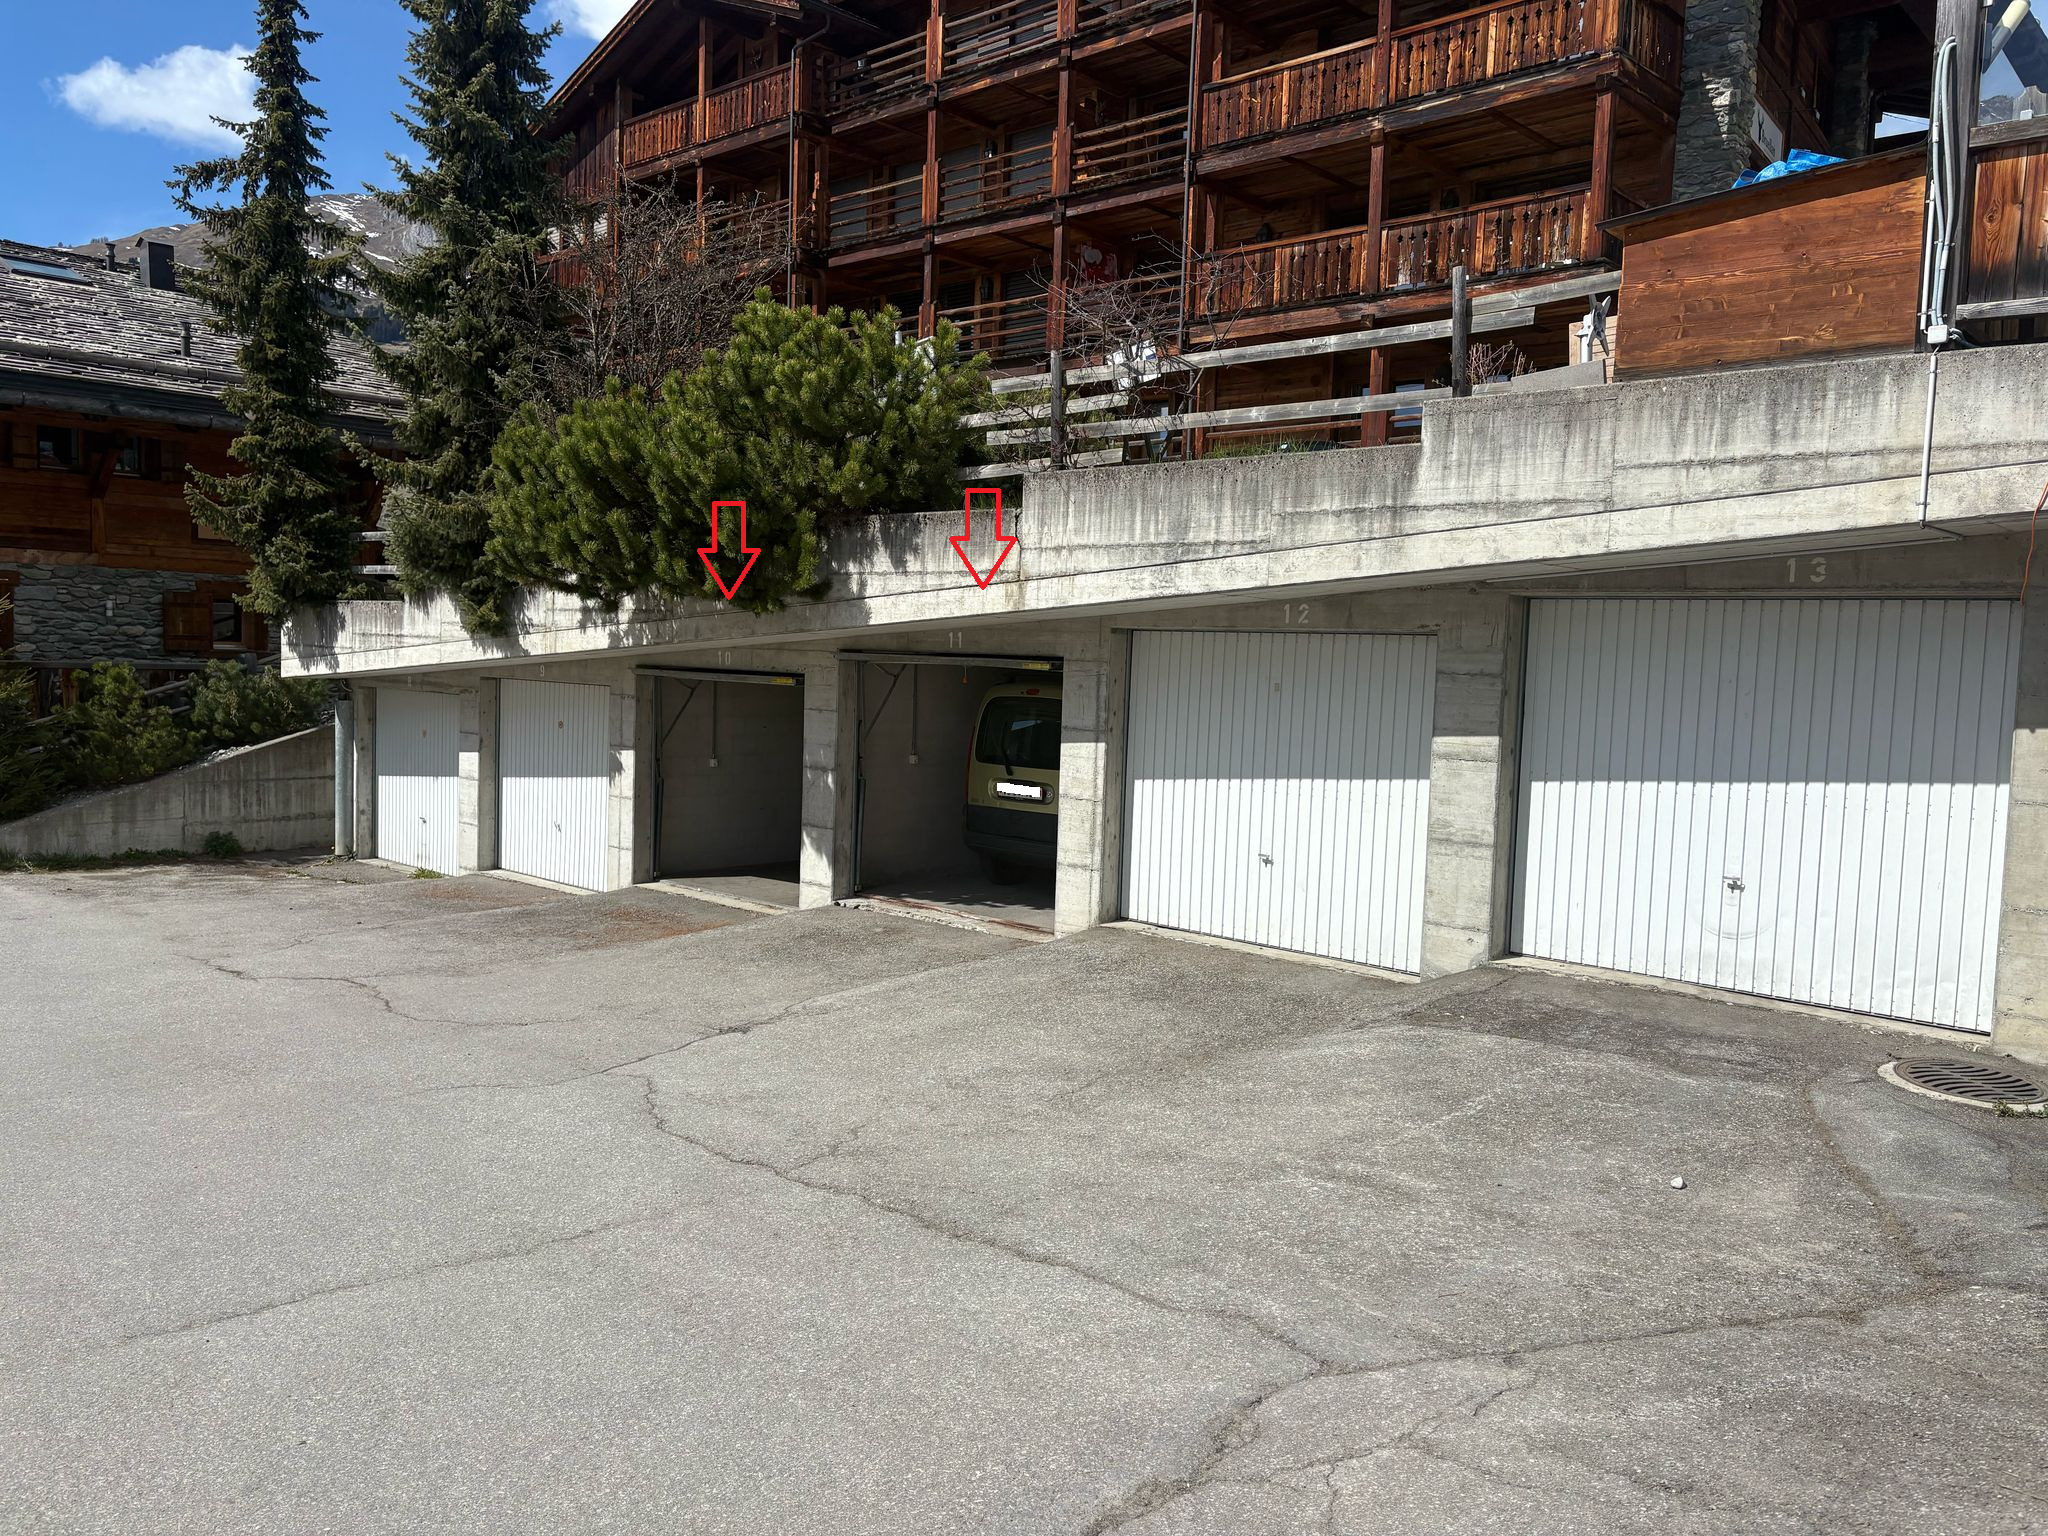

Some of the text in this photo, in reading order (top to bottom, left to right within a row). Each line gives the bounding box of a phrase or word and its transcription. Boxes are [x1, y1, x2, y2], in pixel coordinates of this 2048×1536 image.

[1786, 556, 1828, 583] 13
[1283, 603, 1310, 624] 12
[948, 631, 962, 649] 11
[718, 650, 731, 665] 10
[540, 664, 545, 677] 9
